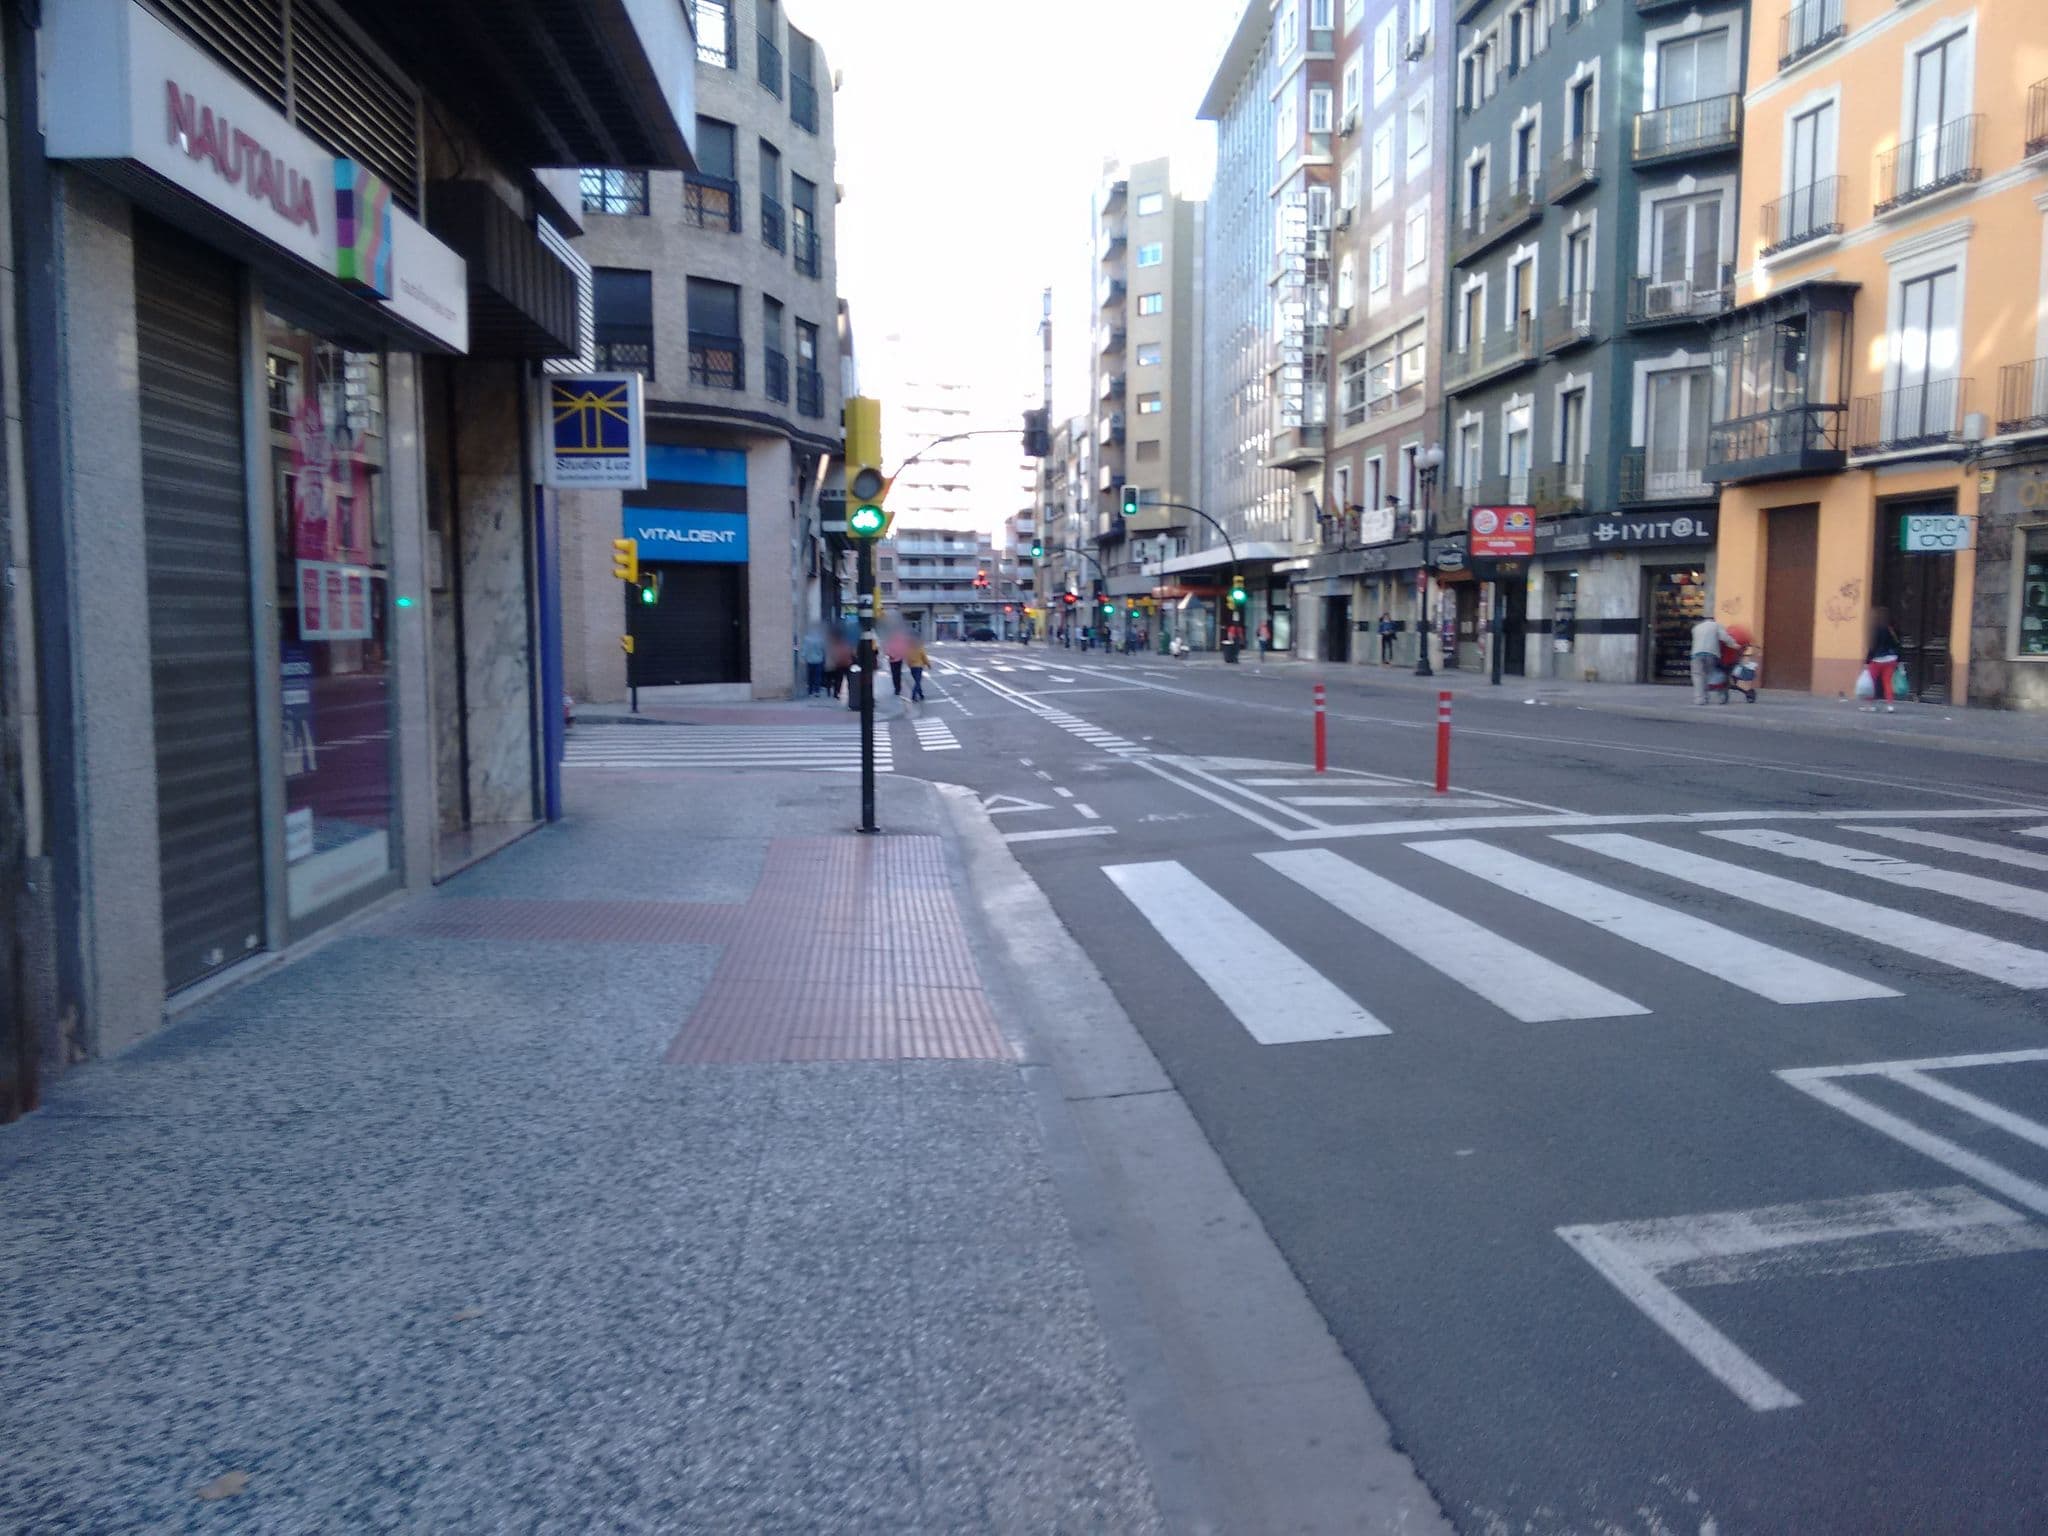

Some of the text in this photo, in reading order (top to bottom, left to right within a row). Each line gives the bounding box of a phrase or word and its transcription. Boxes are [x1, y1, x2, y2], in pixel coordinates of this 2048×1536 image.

[166, 79, 319, 236] NAUTALIA
[556, 458, 631, 471] Studio Luz
[1911, 517, 1967, 532] OPTICA
[638, 527, 736, 543] VITALDENT
